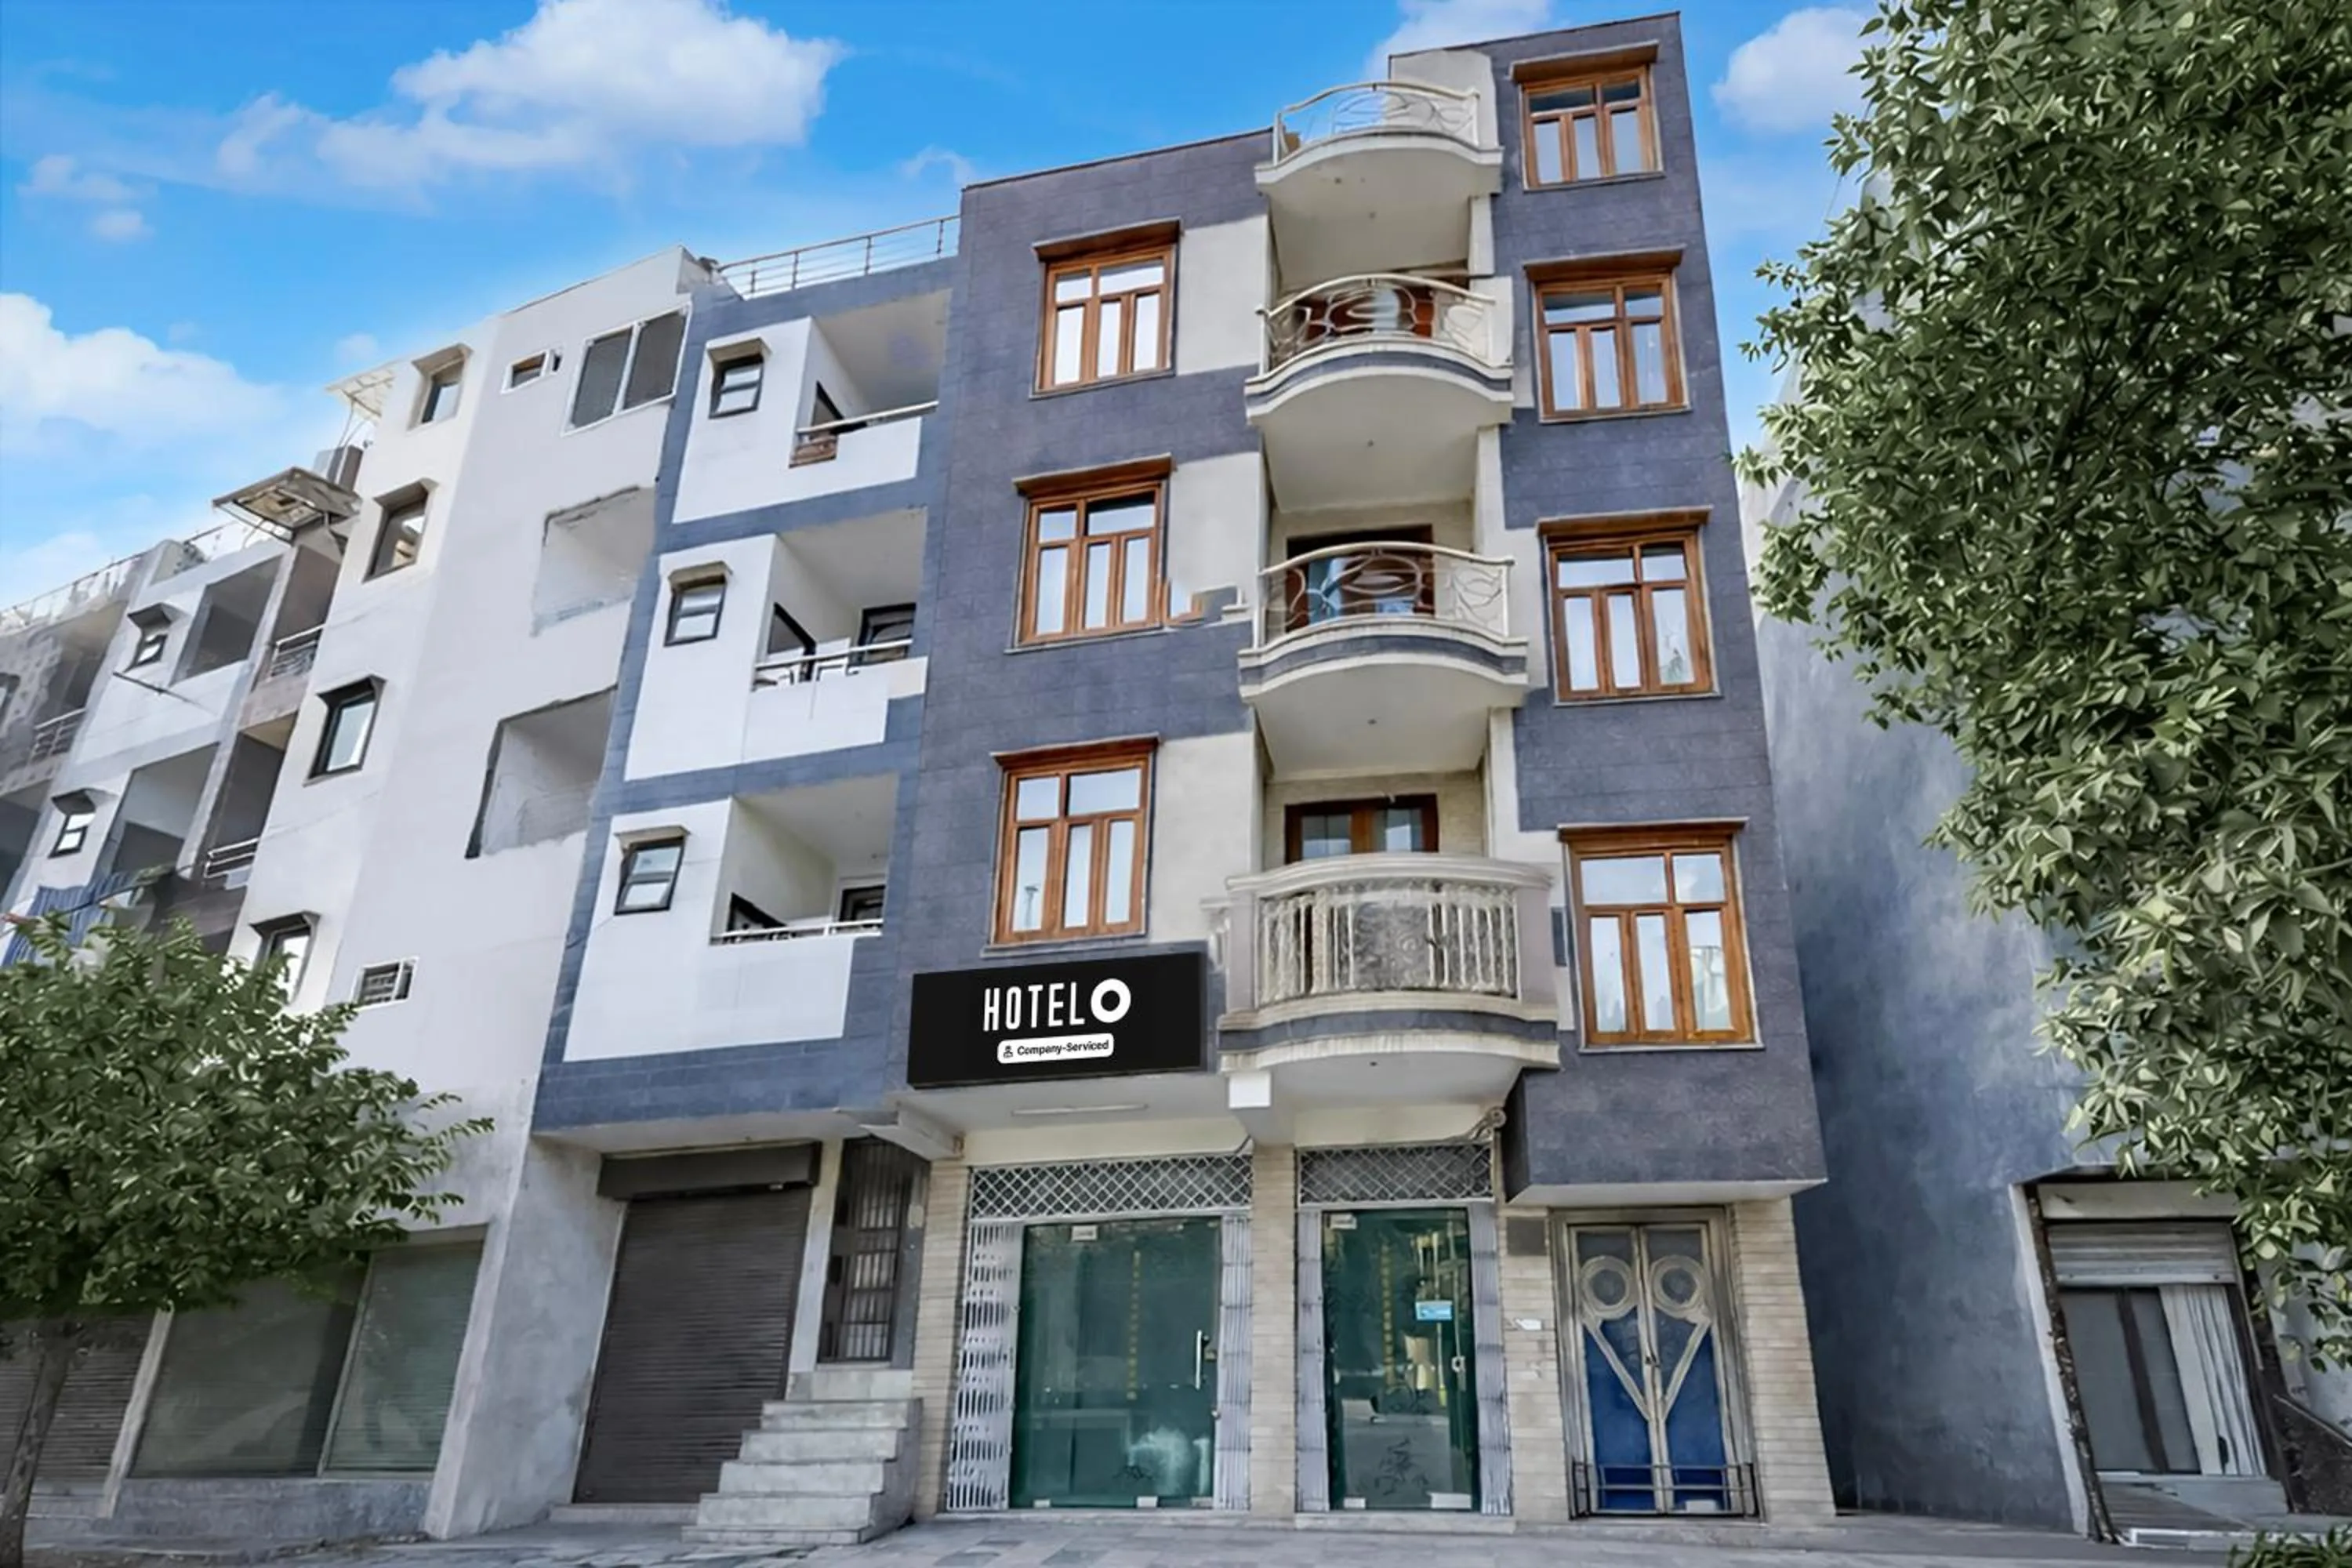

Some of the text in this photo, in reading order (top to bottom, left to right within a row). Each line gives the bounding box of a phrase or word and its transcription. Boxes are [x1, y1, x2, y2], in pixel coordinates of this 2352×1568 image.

[982, 978, 1131, 1032] HOTEL O
[1017, 1039, 1109, 1057] Company-Serviced
